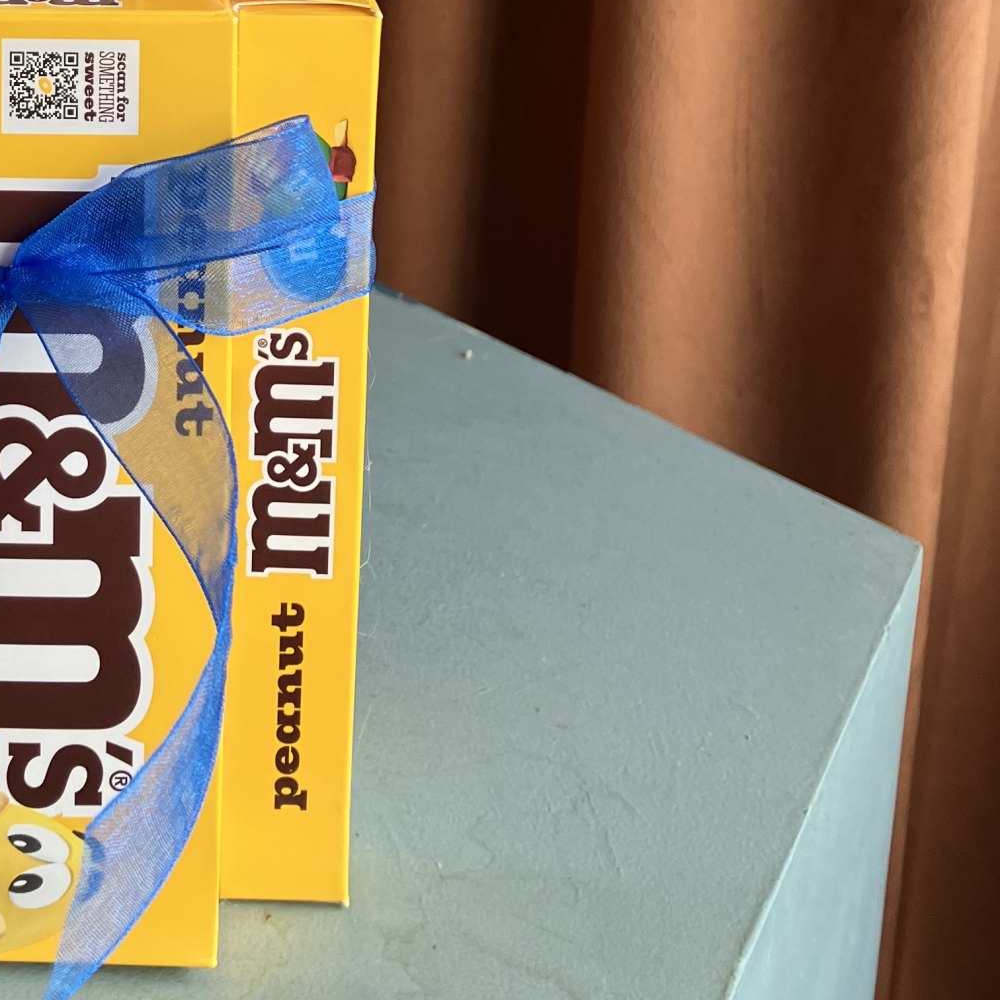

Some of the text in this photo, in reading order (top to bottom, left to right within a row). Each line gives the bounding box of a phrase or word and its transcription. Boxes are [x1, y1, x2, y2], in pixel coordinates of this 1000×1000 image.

[84, 52, 97, 122] sweet
[98, 50, 115, 123] SOMETHING
[115, 51, 130, 122] scan for
[251, 332, 335, 576] m&m's
[272, 601, 307, 812] peanut
